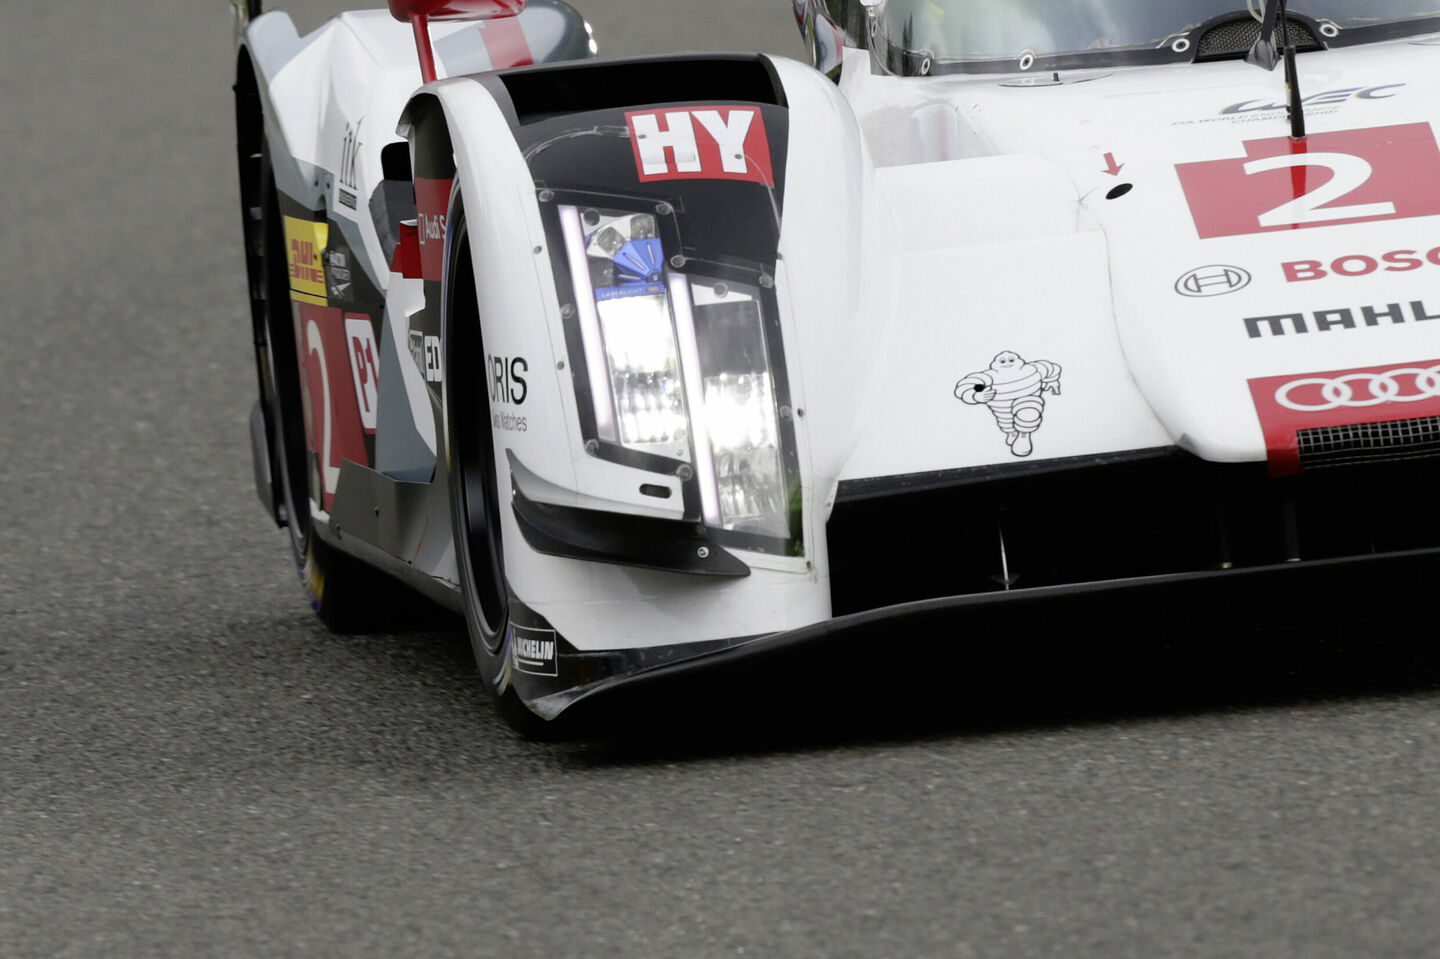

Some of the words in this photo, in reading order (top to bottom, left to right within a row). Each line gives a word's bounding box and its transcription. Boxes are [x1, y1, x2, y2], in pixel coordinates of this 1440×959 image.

[631, 110, 755, 175] HY
[1243, 152, 1396, 227] 2
[306, 319, 341, 494] 2
[487, 354, 528, 405] ORIS
